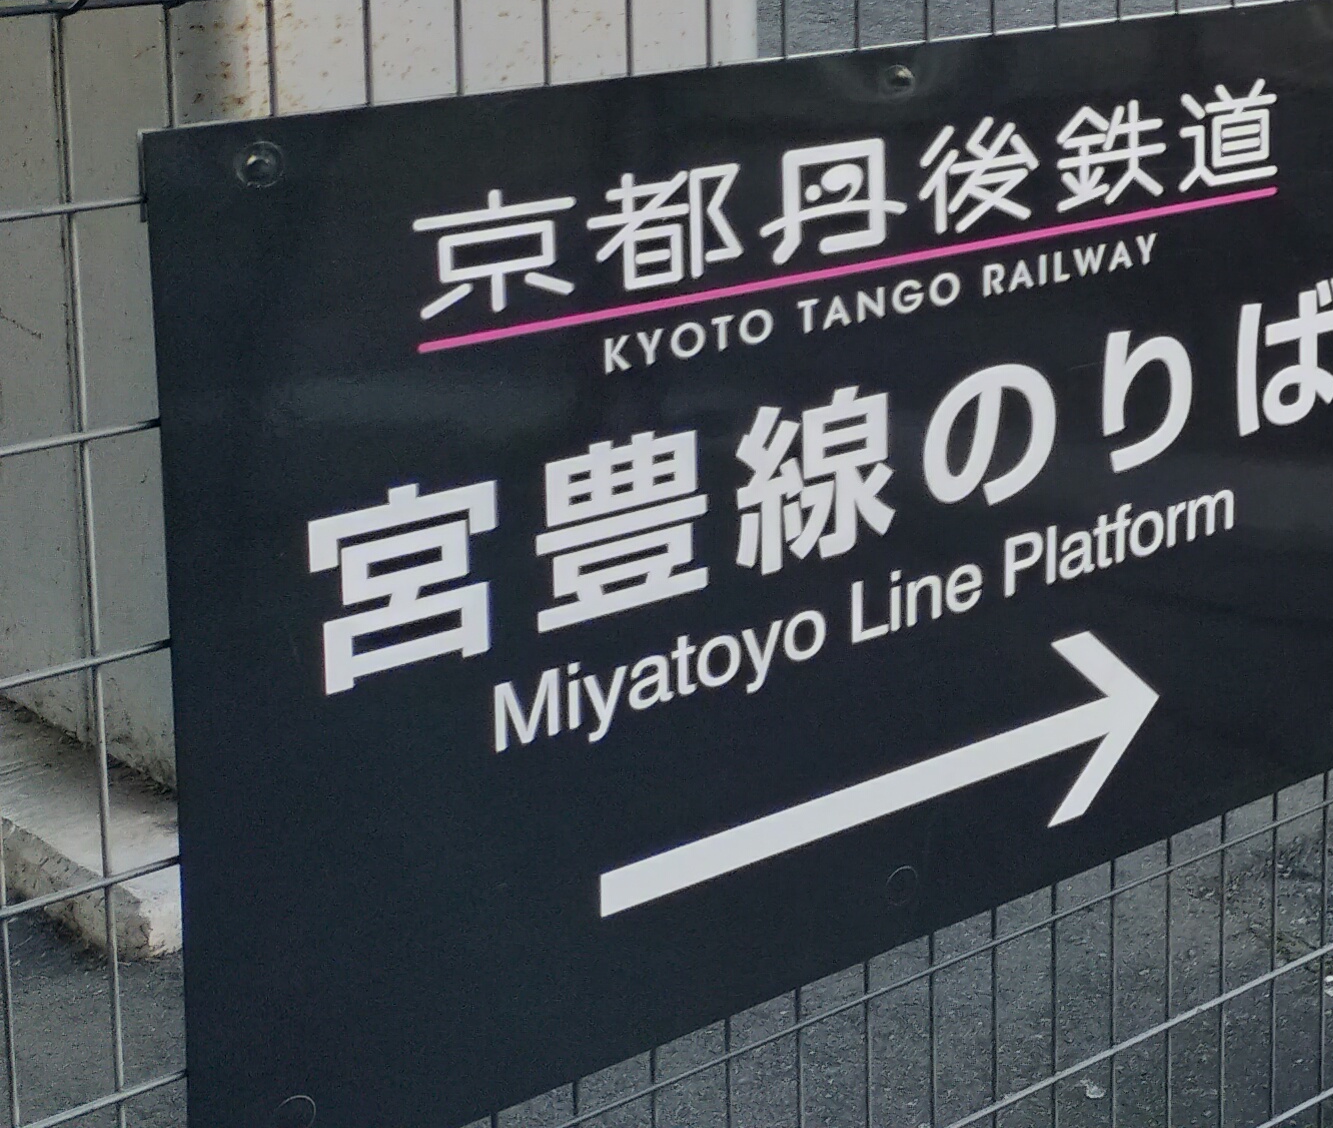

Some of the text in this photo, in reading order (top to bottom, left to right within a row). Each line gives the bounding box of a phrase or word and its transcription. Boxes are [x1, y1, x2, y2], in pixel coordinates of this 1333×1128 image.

[413, 79, 1278, 320] 京都丹後鉄道
[604, 232, 1158, 374] KYOTO TANGO RAILWAY
[493, 489, 1235, 753] Miyatoyo Line Platform
